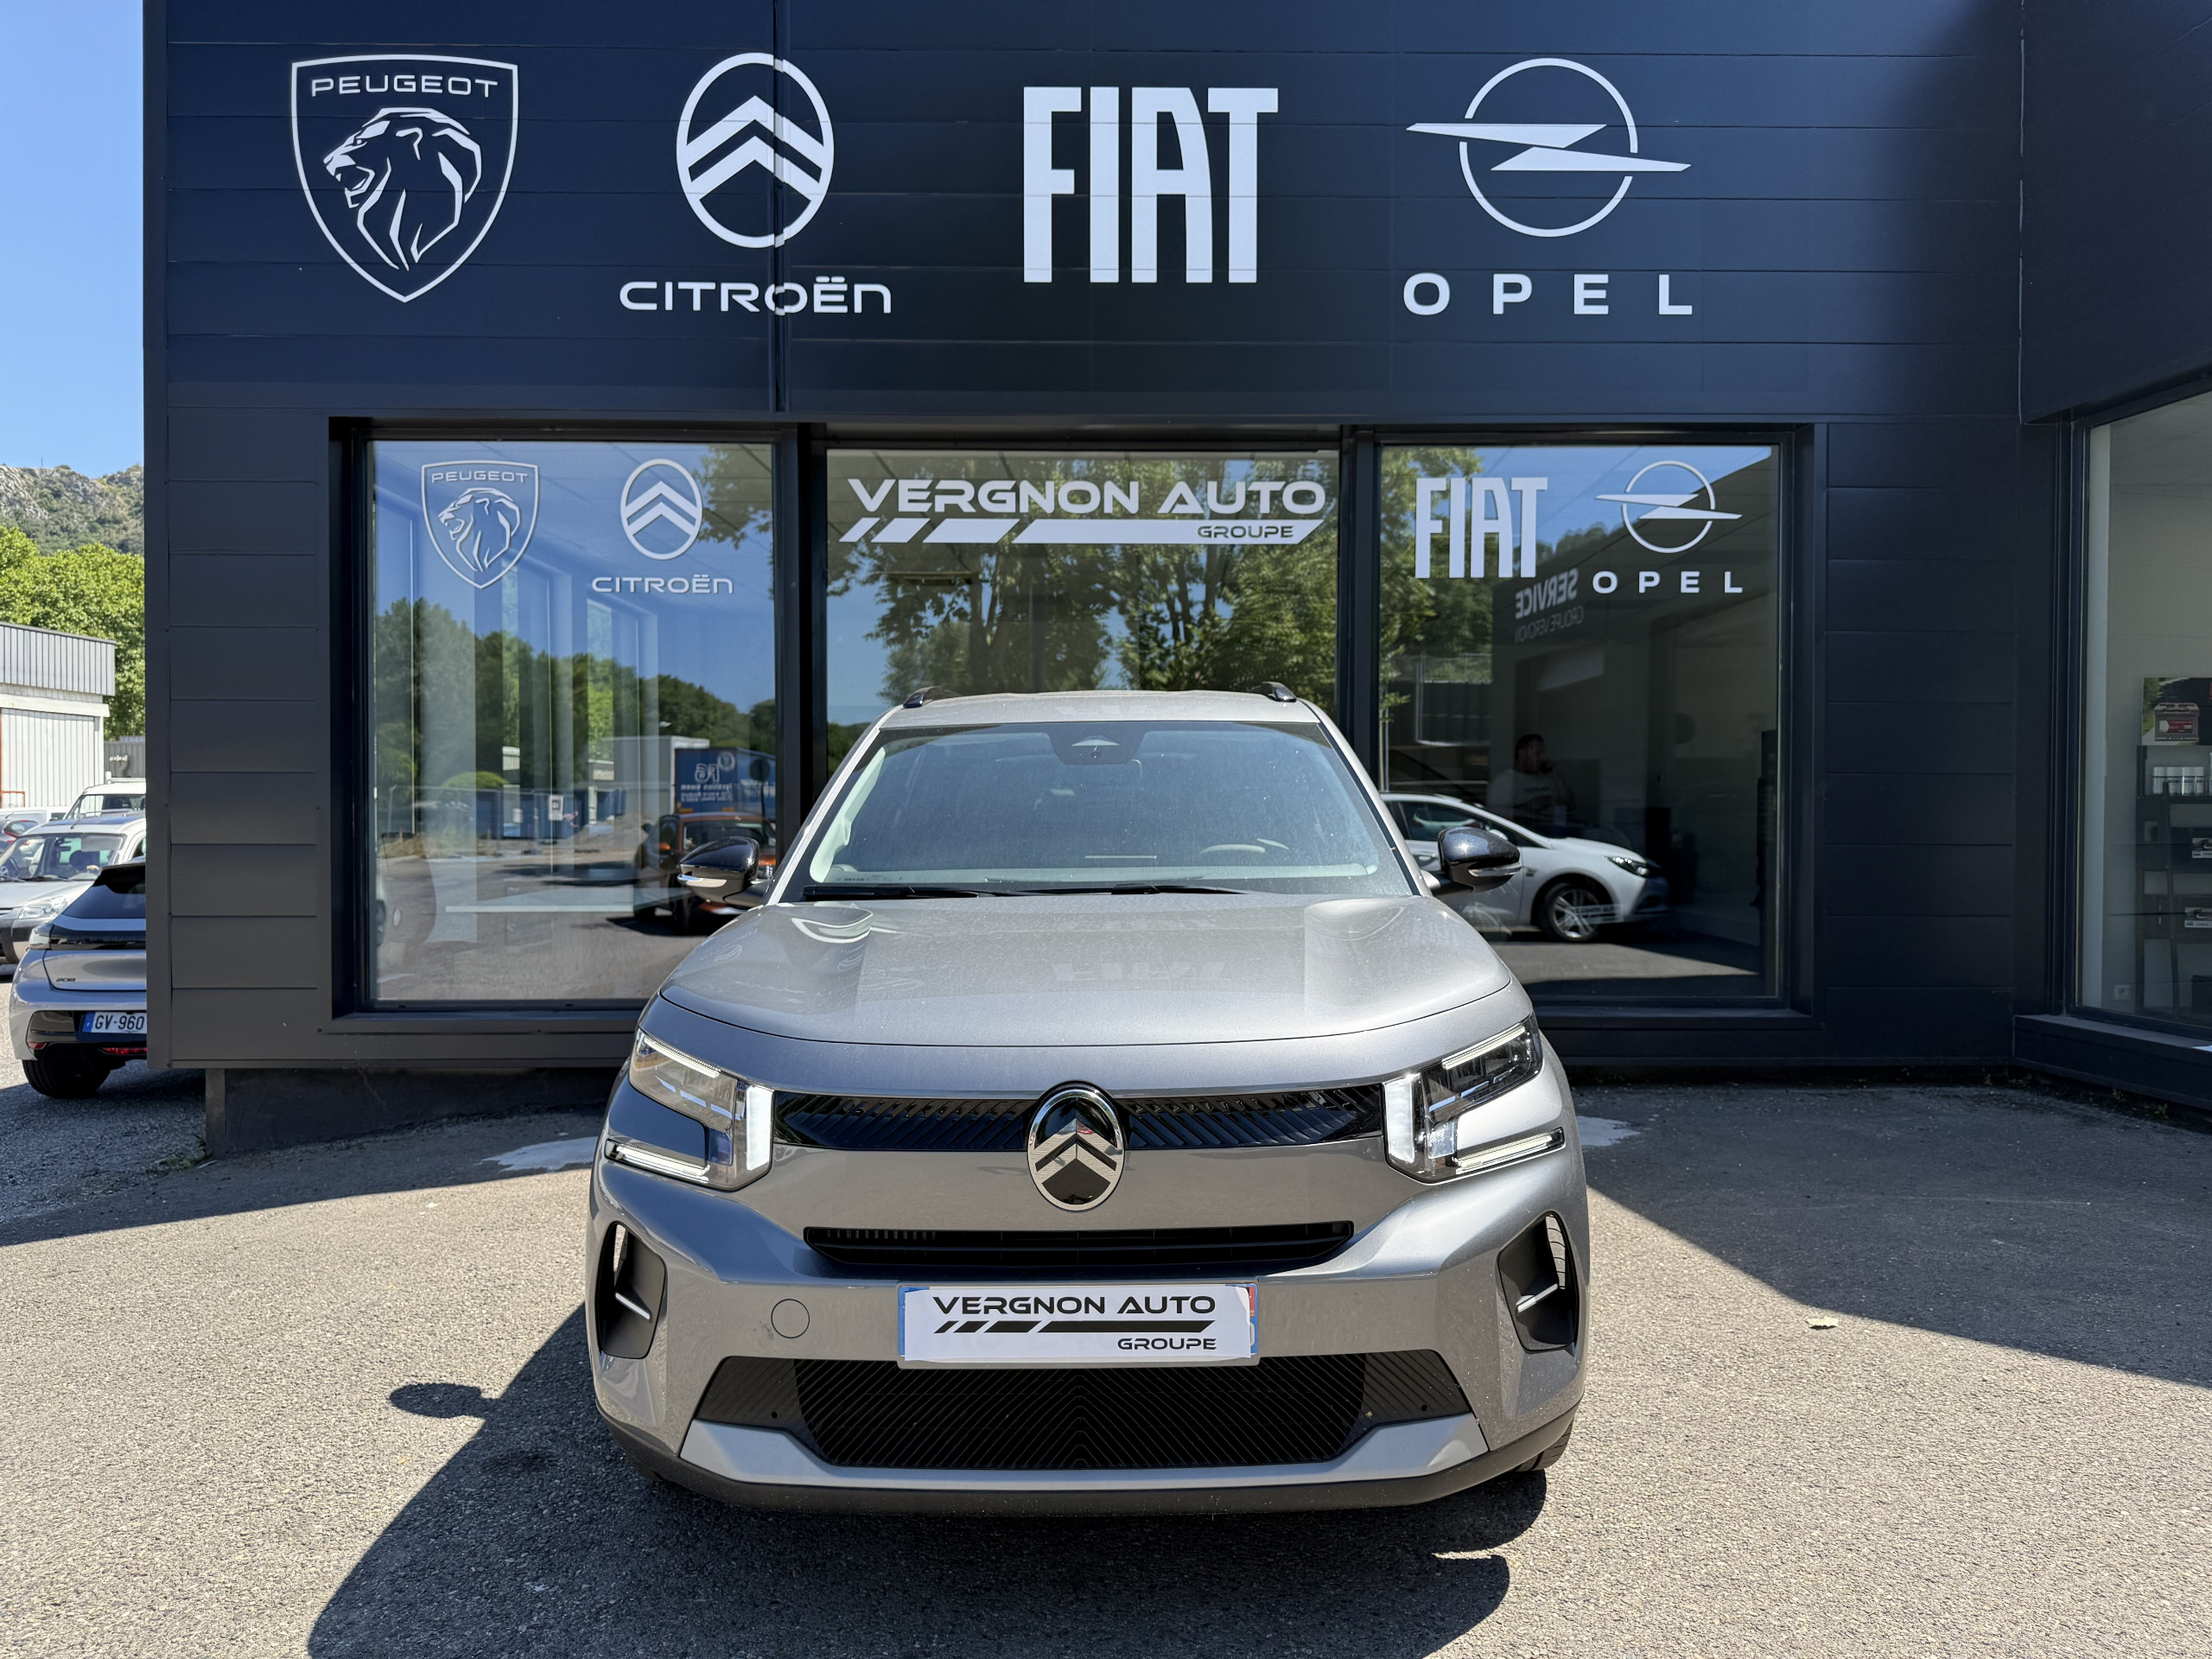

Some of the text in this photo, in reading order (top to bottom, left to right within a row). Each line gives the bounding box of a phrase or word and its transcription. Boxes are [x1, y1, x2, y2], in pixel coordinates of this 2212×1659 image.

[312, 75, 498, 98] PEUGEOT
[1024, 86, 1279, 283] FIAT
[620, 276, 892, 316] CITROËN
[1403, 273, 1693, 315] OPEL
[431, 470, 528, 484] PEUGEOT
[848, 478, 1326, 514] VERGNON AUTO
[1197, 525, 1294, 538] GROUPE
[1414, 477, 1548, 578] FIAT
[591, 574, 734, 594] CITROËN
[1592, 570, 1744, 594] OPEL
[932, 1295, 1216, 1315] VERGNON AUTO
[1117, 1338, 1217, 1351] GROUPE
